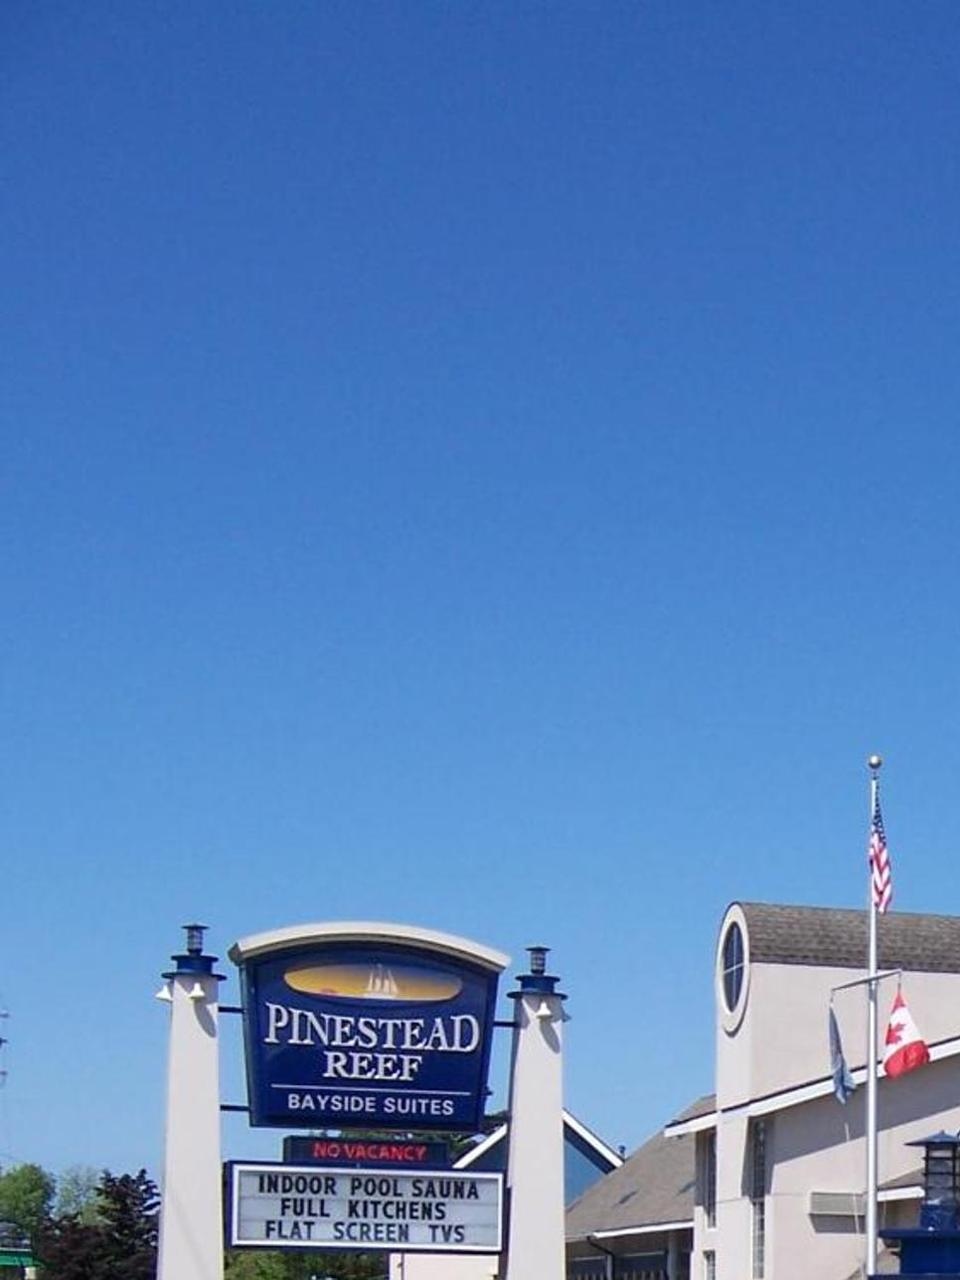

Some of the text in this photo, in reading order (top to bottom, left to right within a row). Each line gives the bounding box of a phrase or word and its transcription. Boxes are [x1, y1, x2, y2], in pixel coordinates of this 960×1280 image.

[264, 1002, 480, 1052] PINESTEAD
[322, 1051, 422, 1081] REEF
[287, 1093, 454, 1115] BAYSIDE SUITES
[313, 1142, 427, 1161] NO VACANCY
[258, 1174, 479, 1199] INDOOR POOL SAUNA
[280, 1198, 446, 1221] FULL KITCHENS
[265, 1220, 465, 1243] FLAT SCREEN TVS
